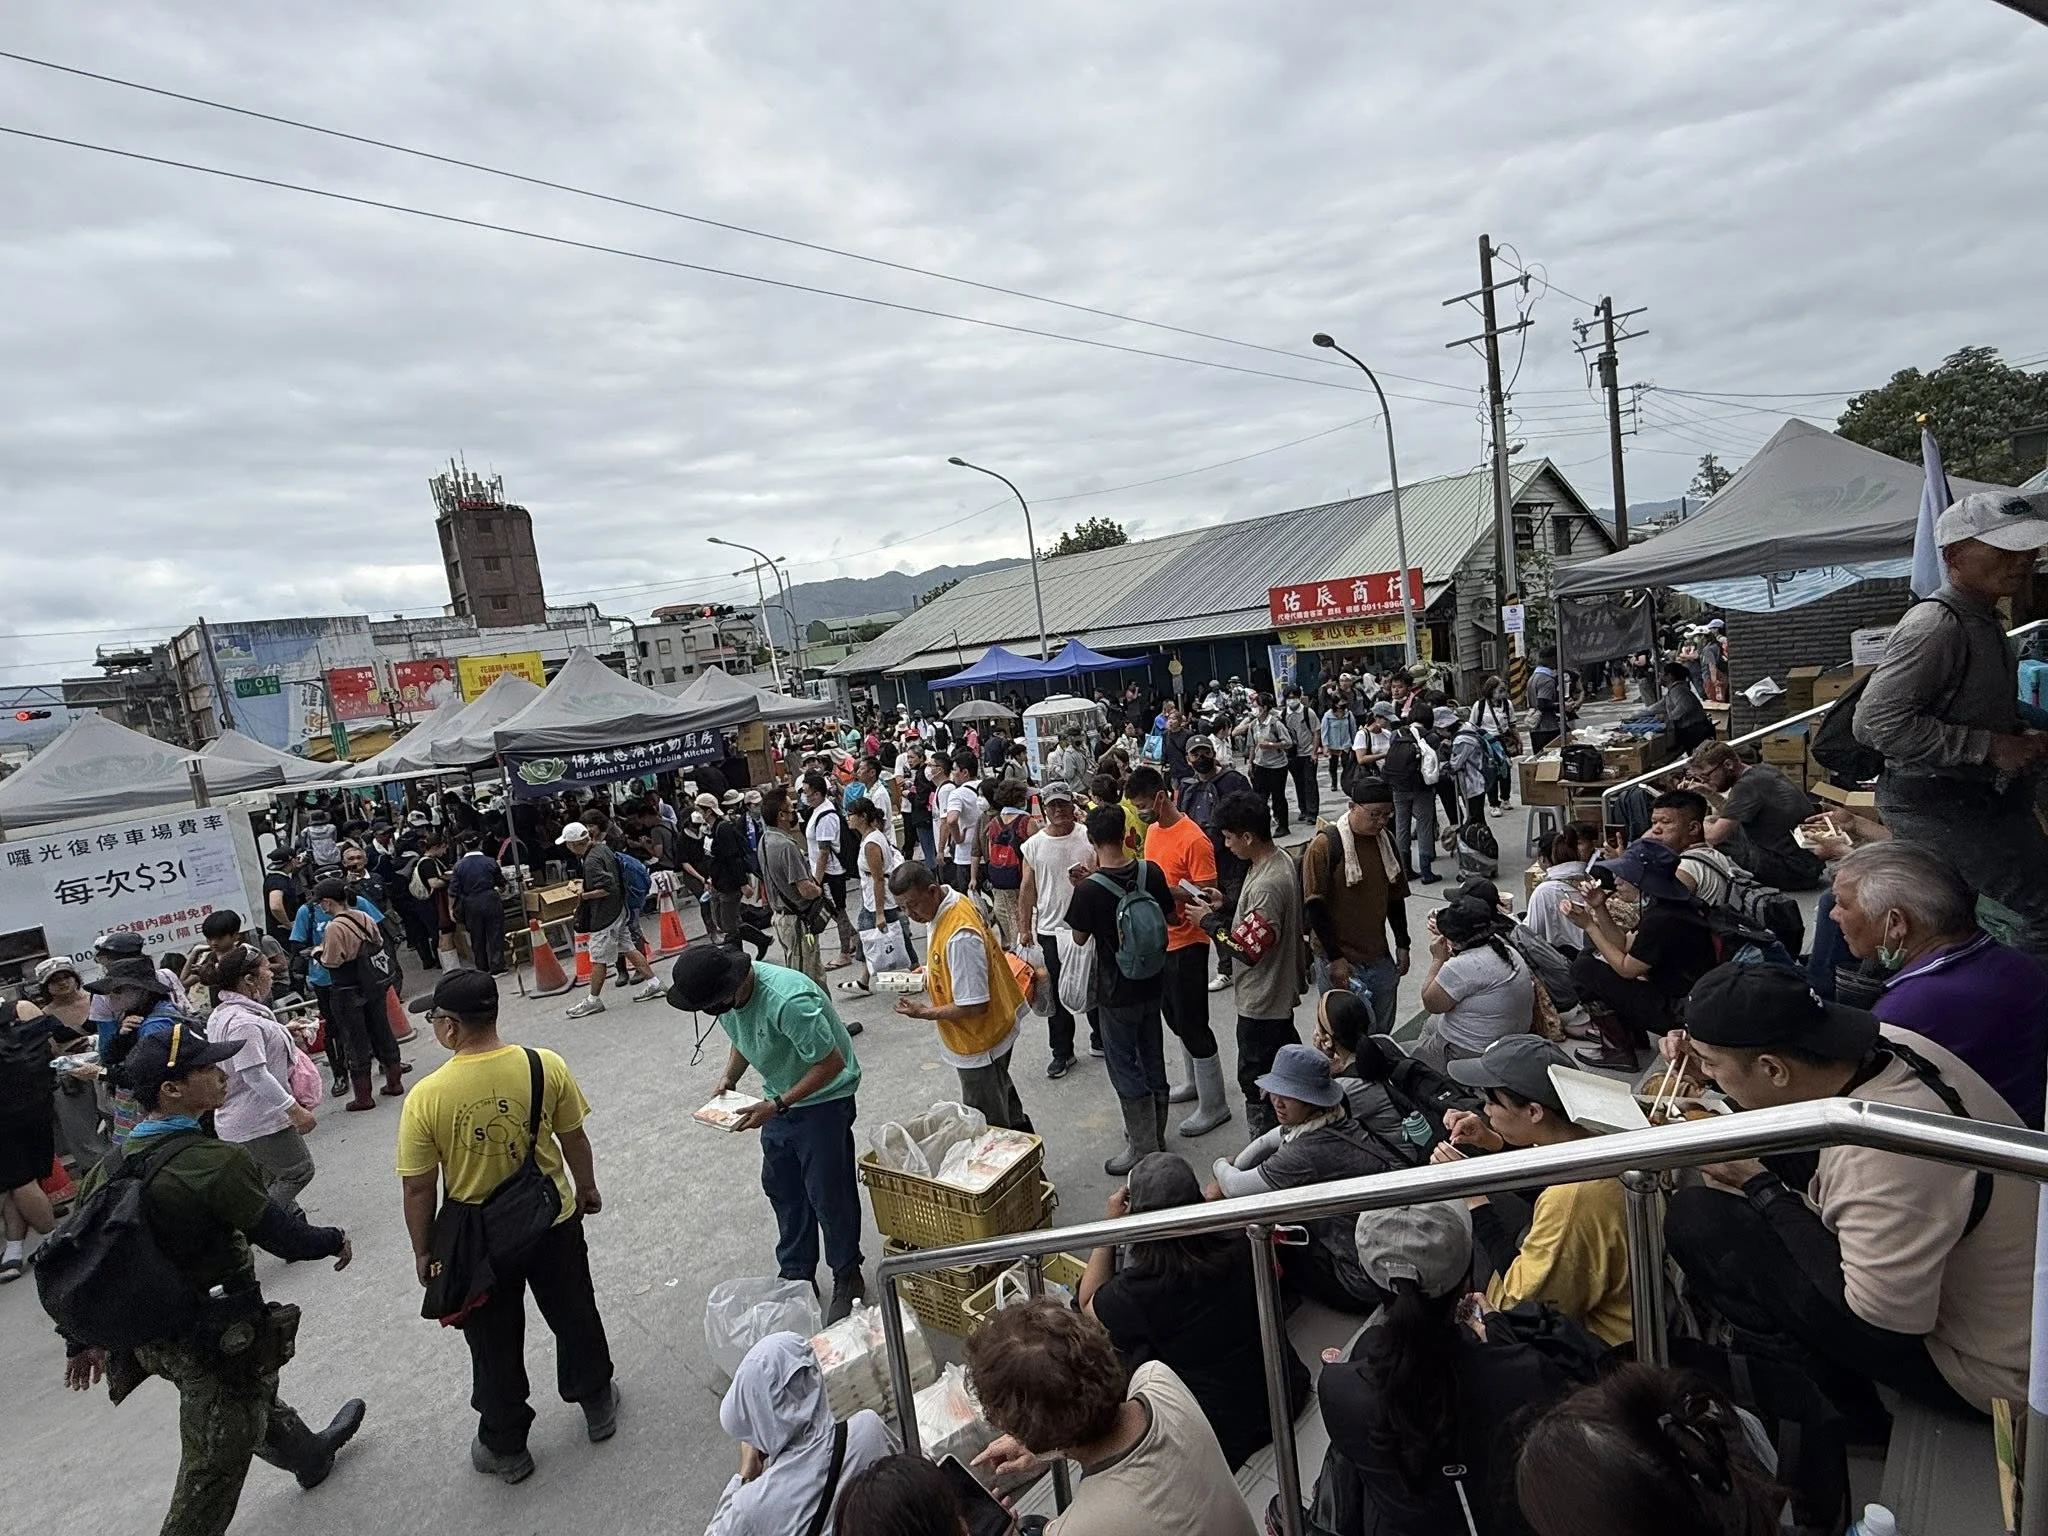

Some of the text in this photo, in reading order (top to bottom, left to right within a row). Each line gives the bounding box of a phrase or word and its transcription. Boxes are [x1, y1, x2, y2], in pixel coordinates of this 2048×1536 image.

[576, 746, 715, 780] Buddhist Tzu Chi Mobile Kitchen
